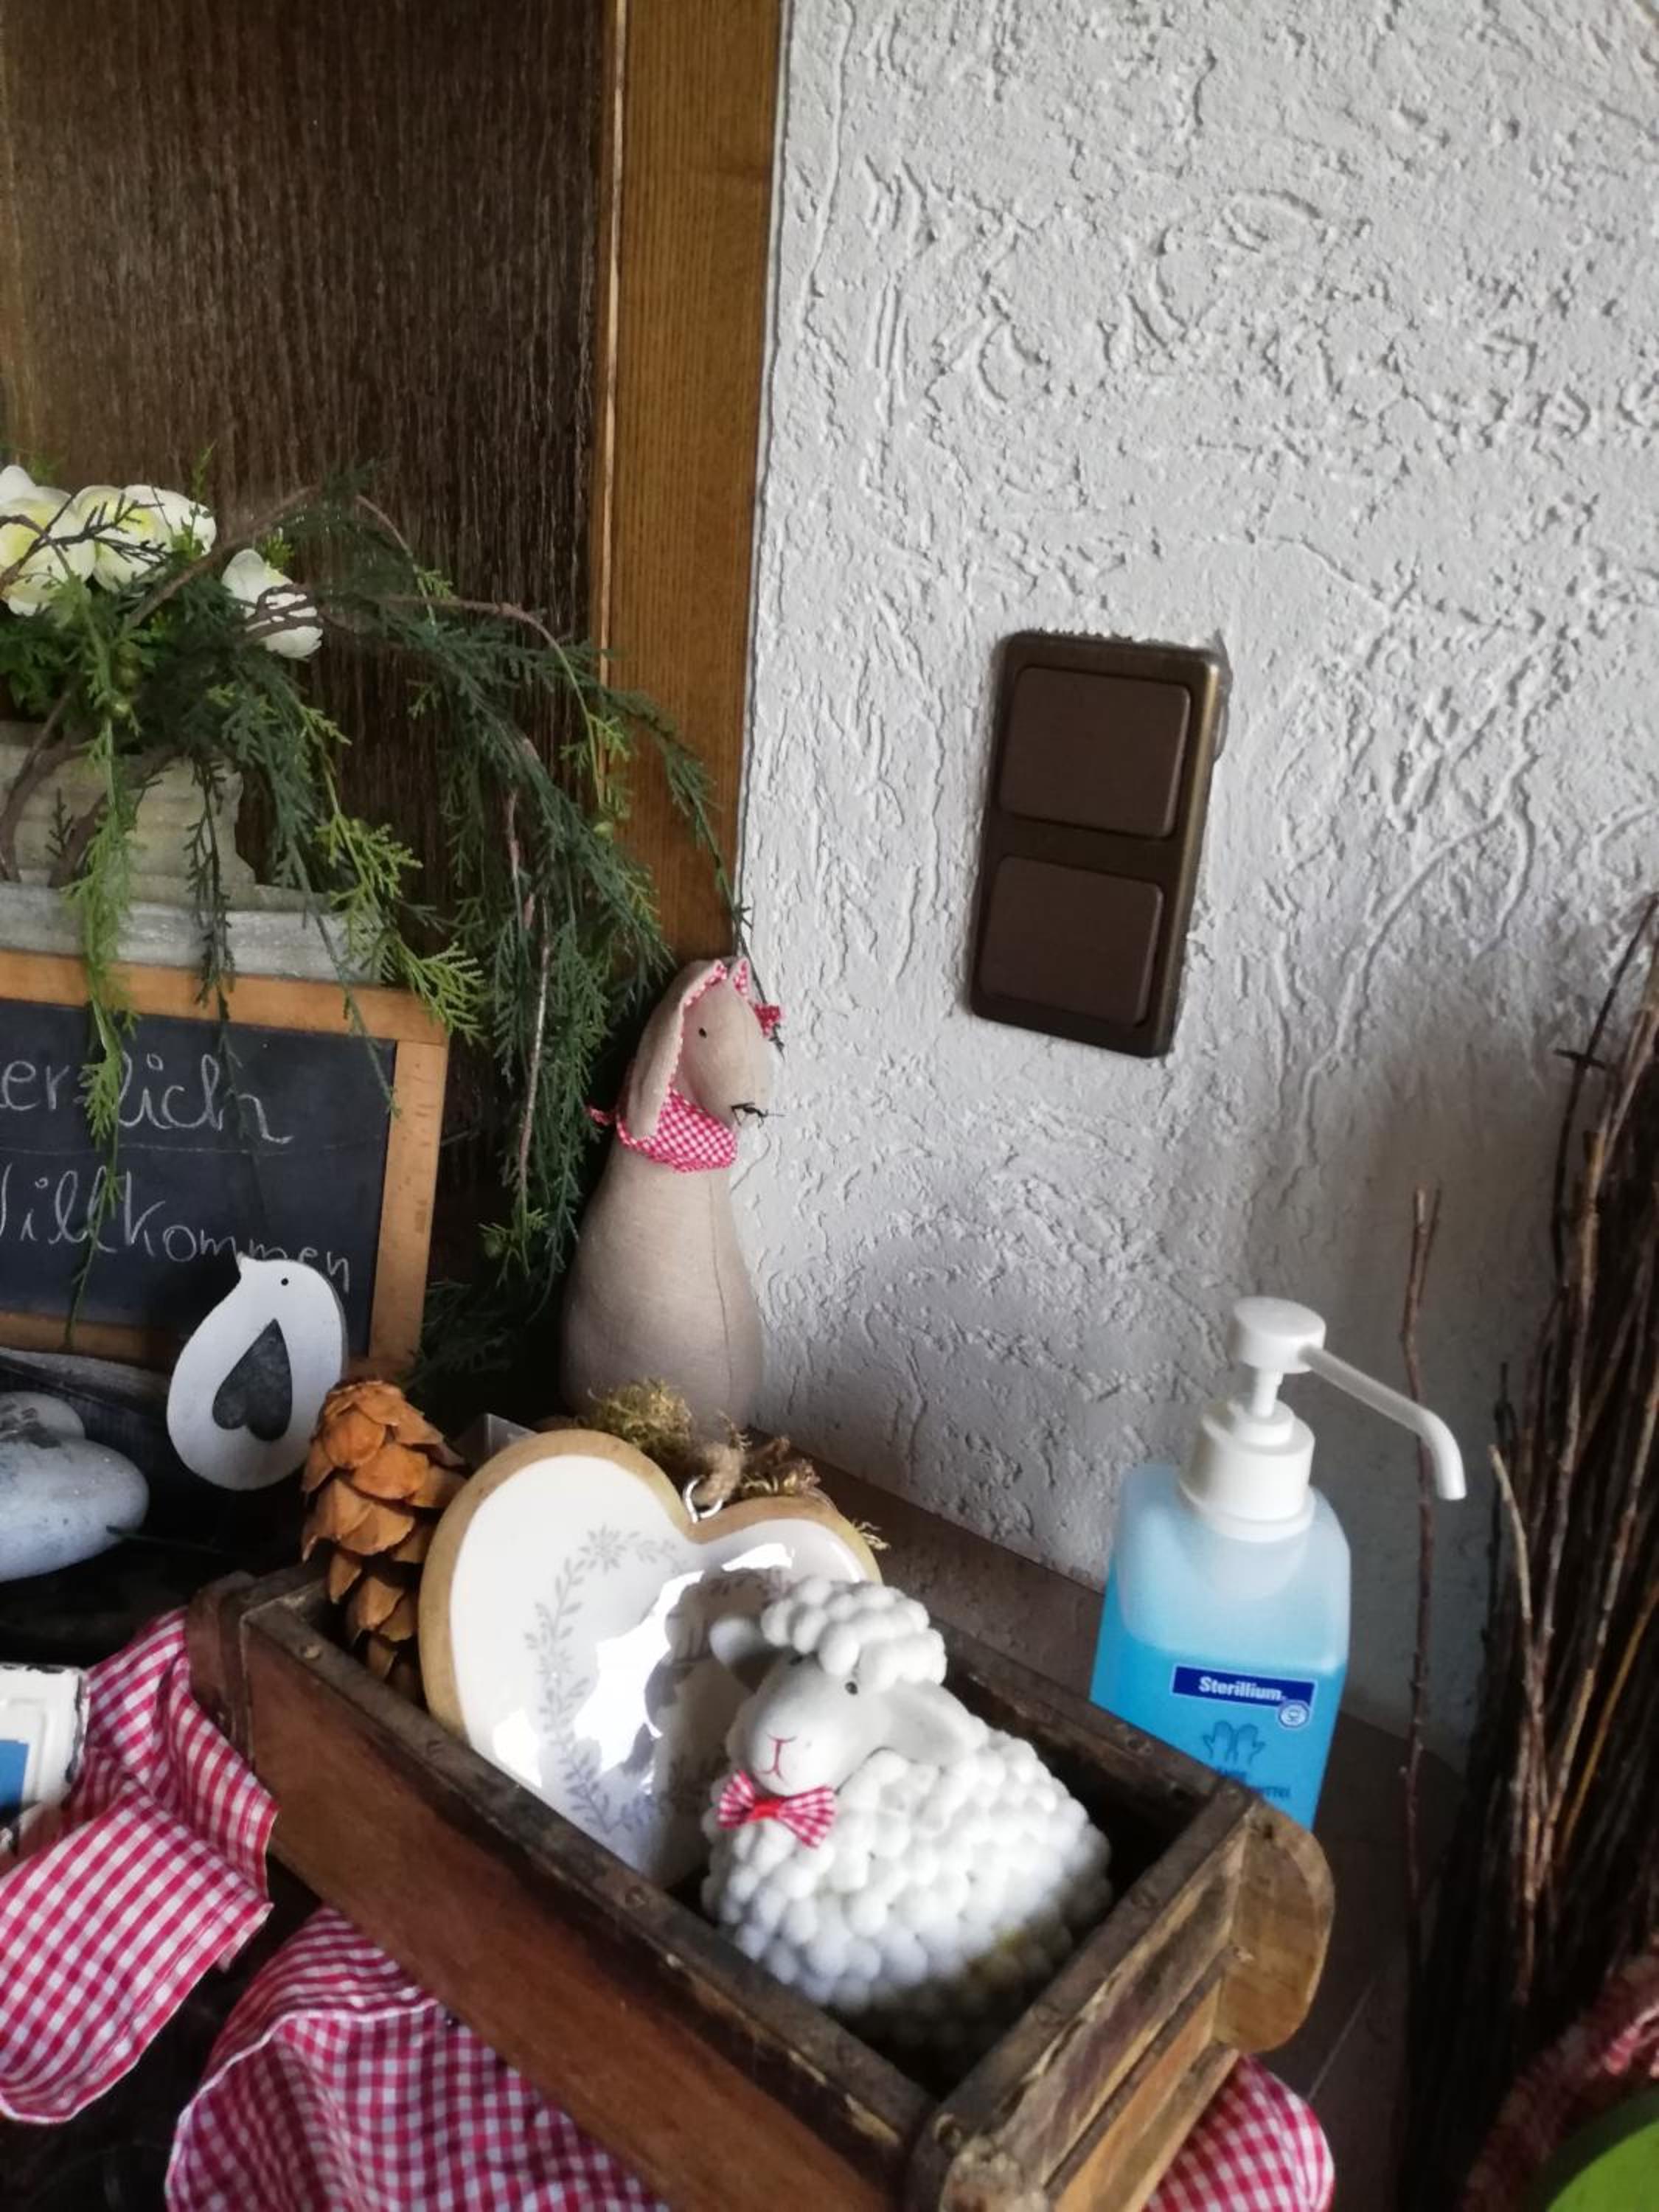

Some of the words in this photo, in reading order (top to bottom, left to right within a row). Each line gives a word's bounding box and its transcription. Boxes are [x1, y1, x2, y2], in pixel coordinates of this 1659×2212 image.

[0, 1054, 294, 1145] erlich
[0, 1163, 350, 1294] illkommen
[1199, 1676, 1284, 1700] Sterillium
